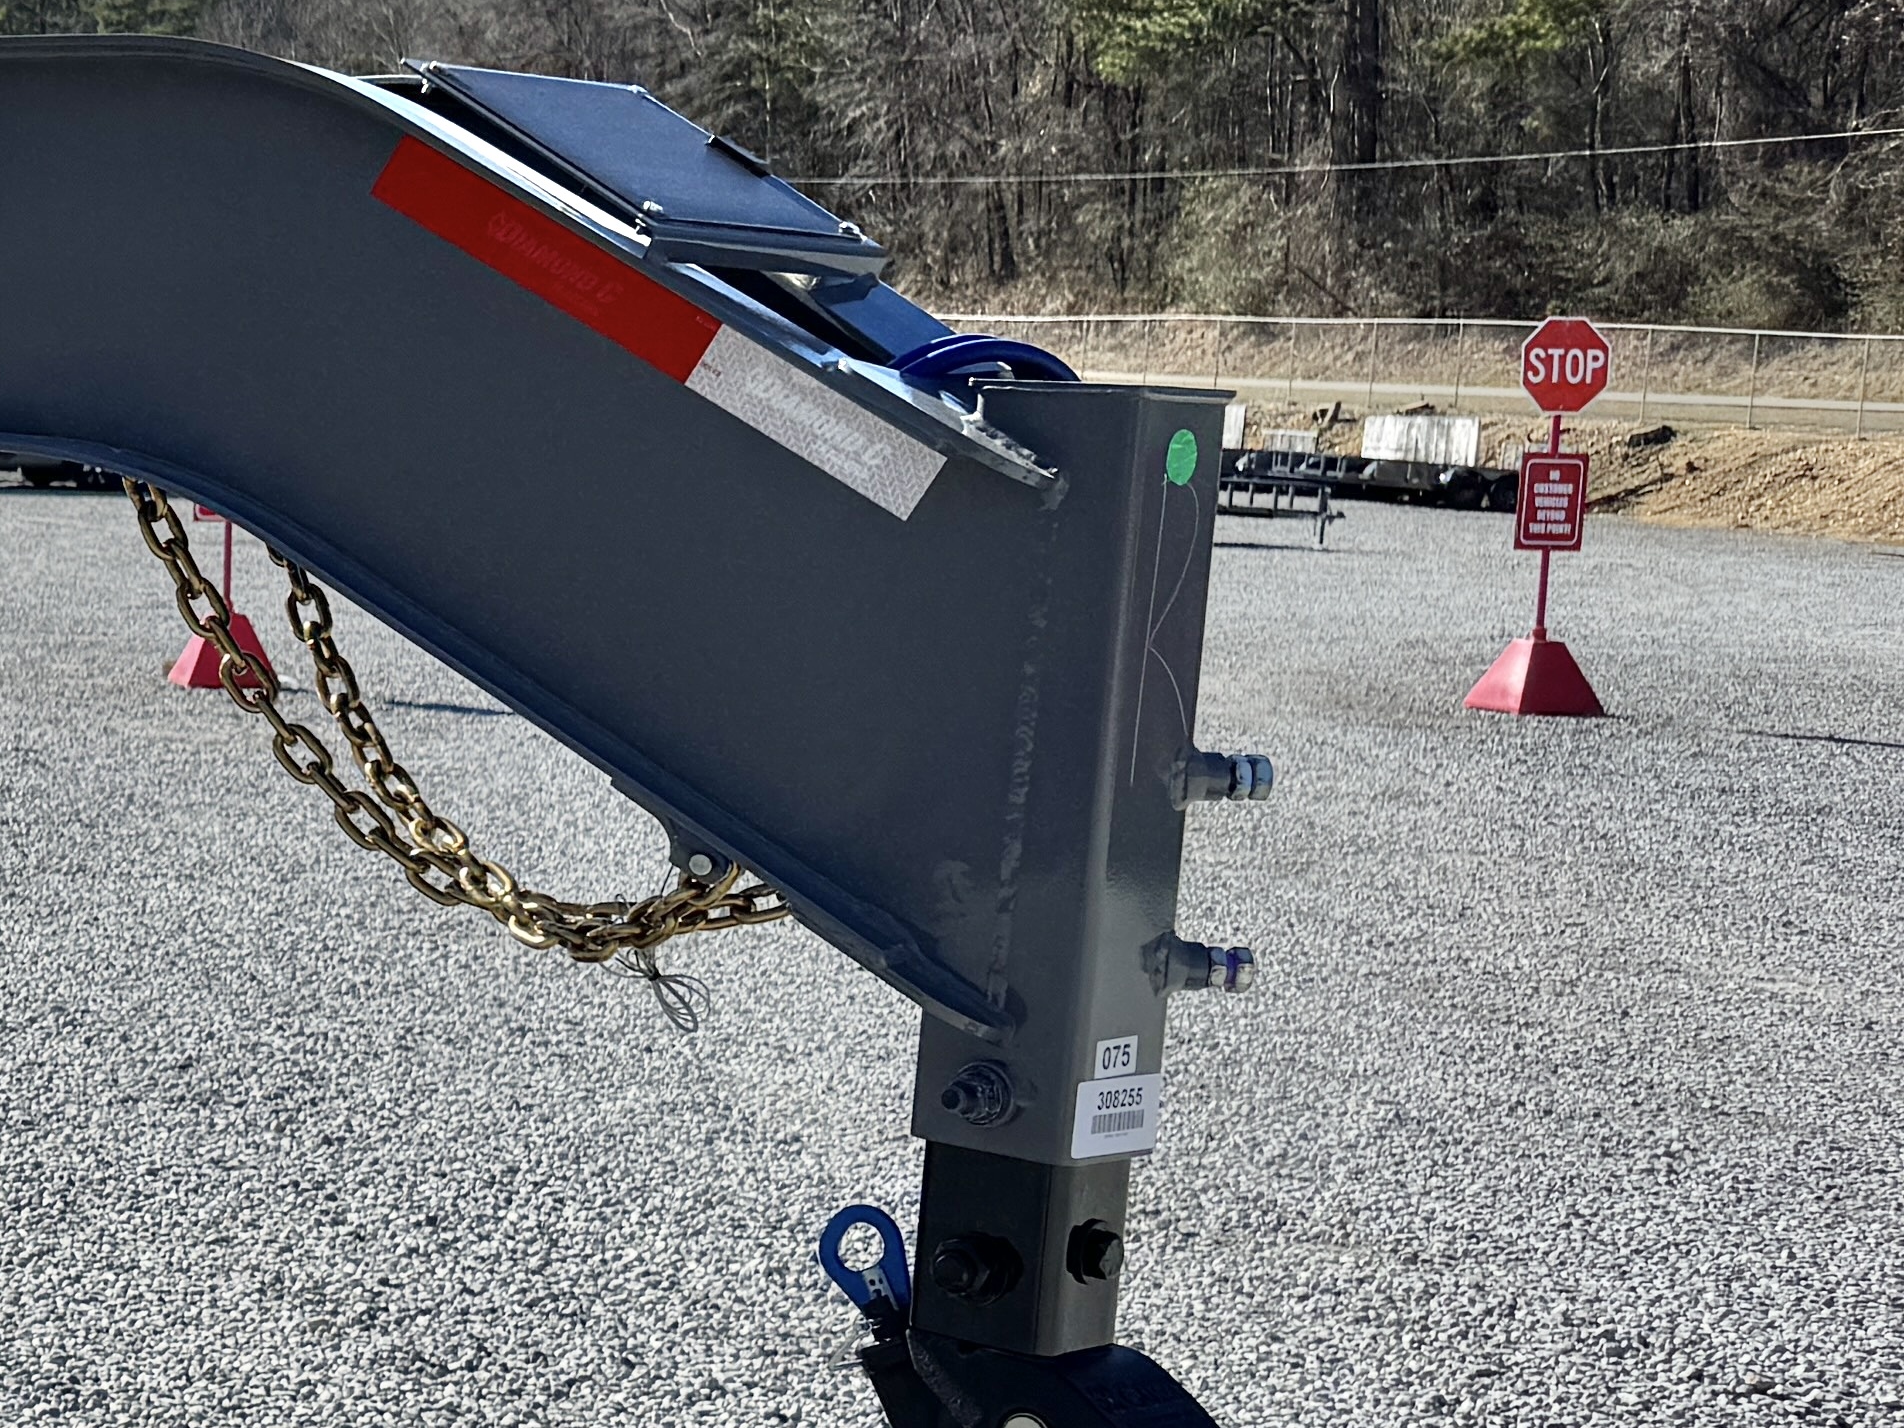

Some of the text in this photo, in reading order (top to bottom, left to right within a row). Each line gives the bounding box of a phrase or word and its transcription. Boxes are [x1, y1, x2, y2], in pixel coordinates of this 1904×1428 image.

[1527, 347, 1605, 385] STOP
[1102, 1043, 1131, 1070] 075
[1097, 1087, 1143, 1110] 308255
